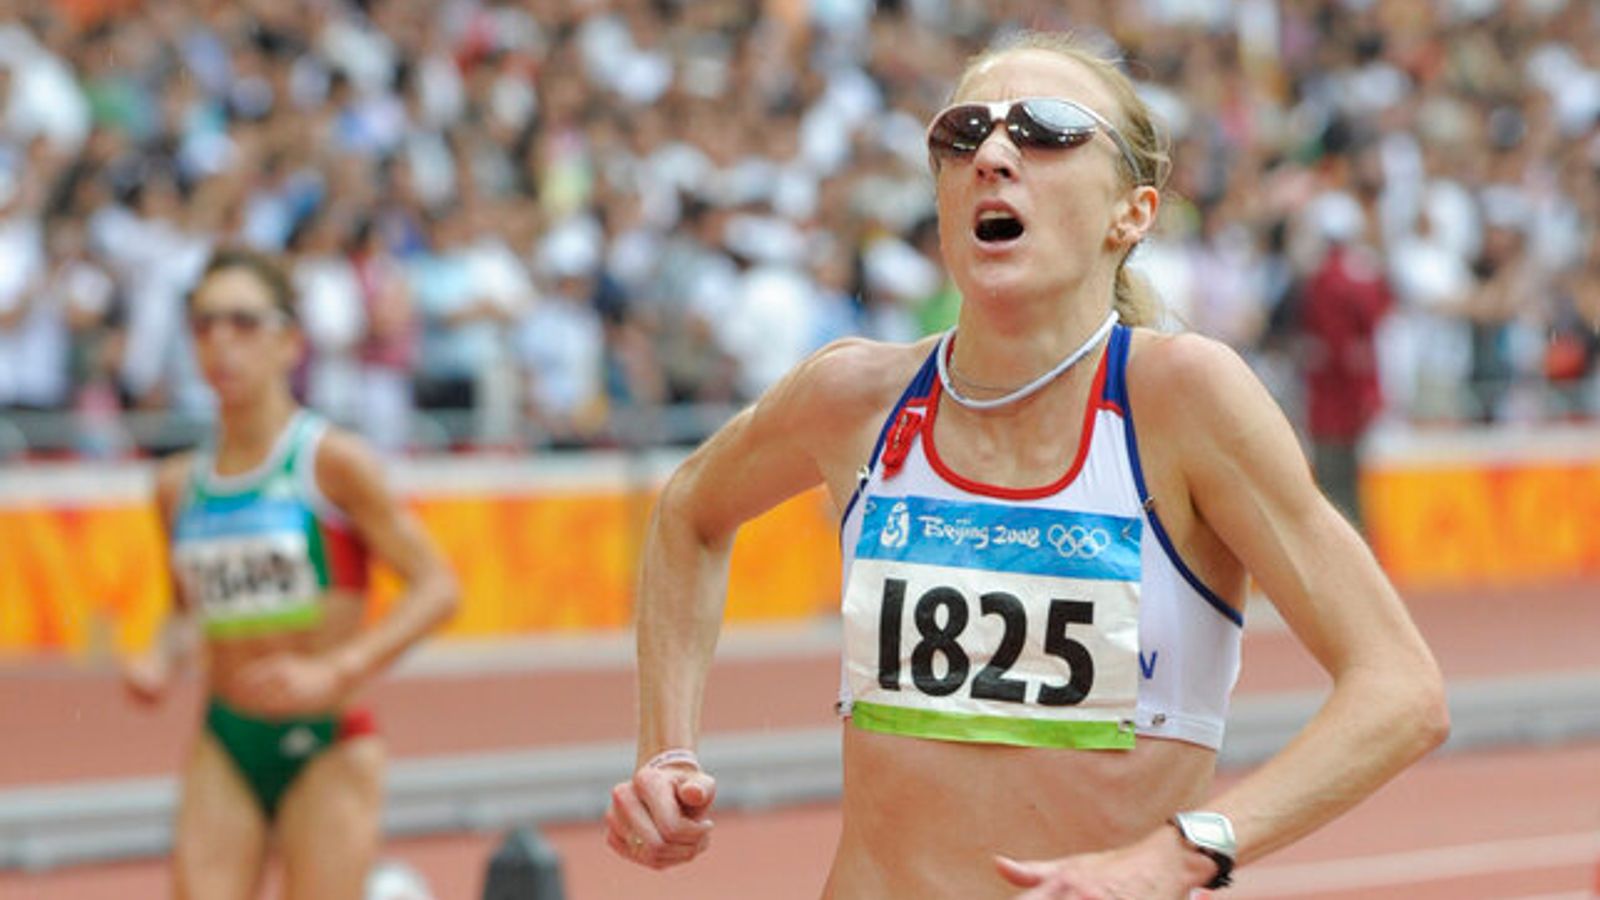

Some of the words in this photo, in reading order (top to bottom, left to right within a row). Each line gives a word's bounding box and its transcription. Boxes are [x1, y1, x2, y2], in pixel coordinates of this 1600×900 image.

[919, 515, 990, 549] Beijing
[992, 525, 1040, 548] 2008
[878, 578, 1094, 706] 1825
